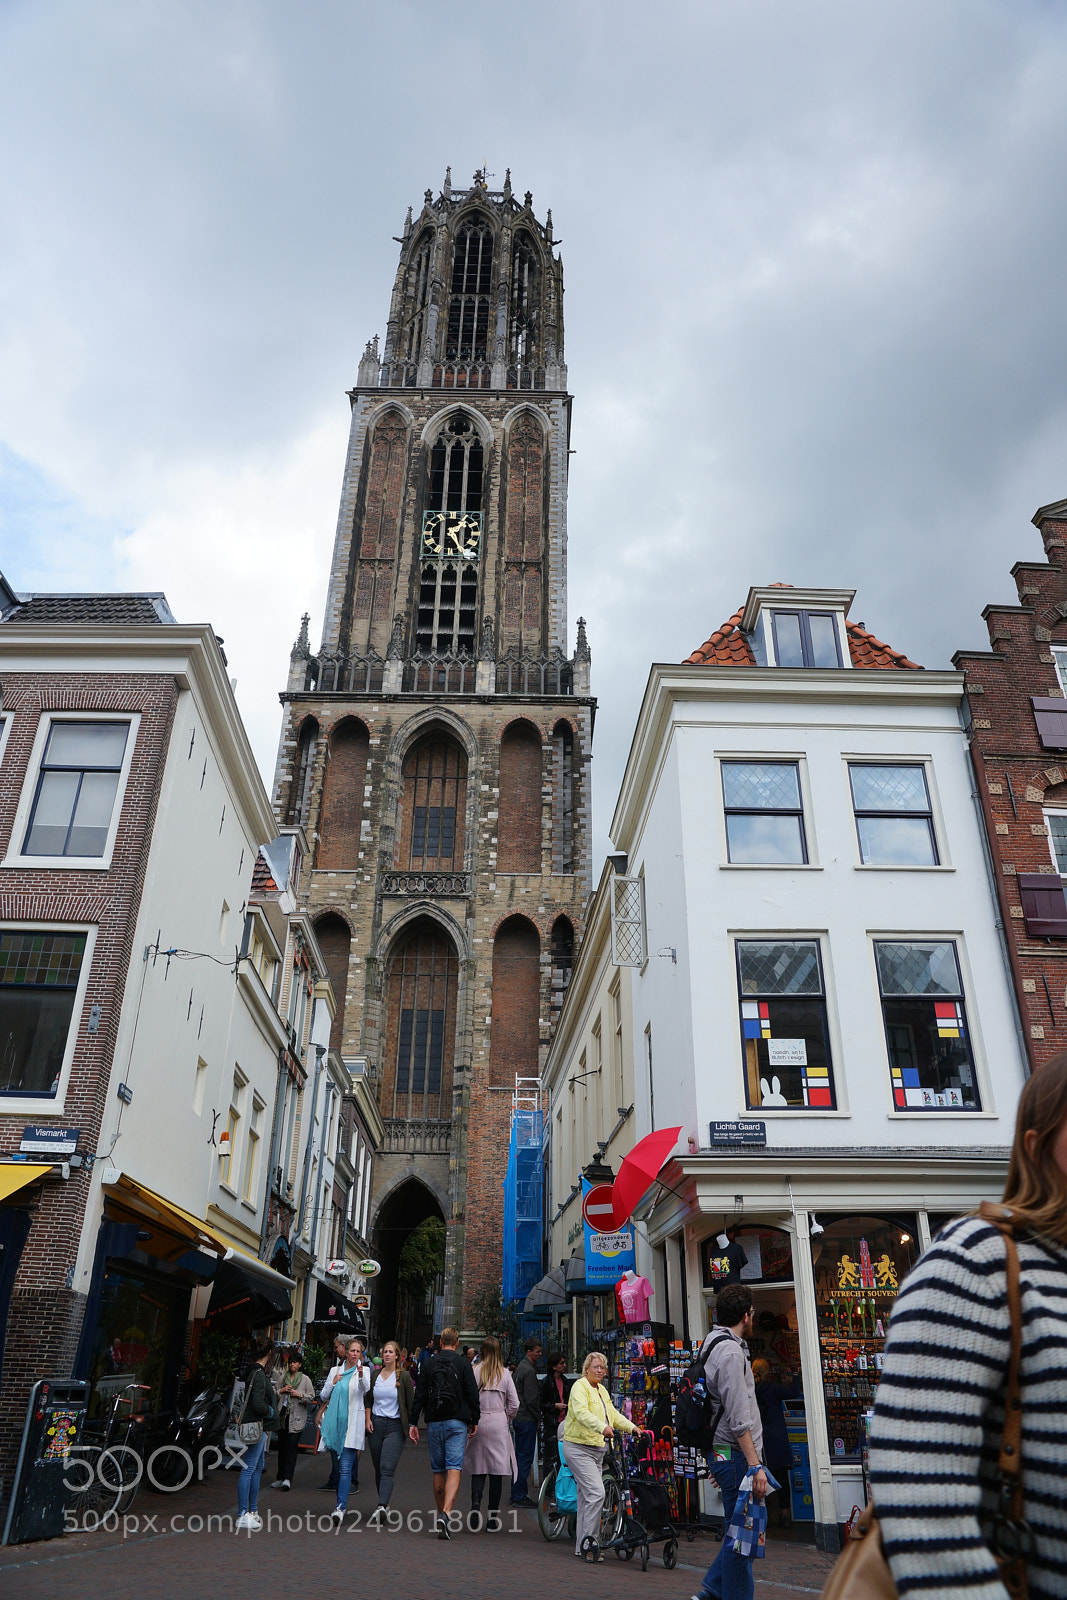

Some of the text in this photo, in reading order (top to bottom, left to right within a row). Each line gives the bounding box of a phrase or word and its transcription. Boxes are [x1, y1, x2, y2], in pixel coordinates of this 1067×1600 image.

[715, 1122, 760, 1130] Lichte Gaard
[35, 1128, 68, 1138] Vismarkt
[592, 1234, 629, 1242] uitgezonderd
